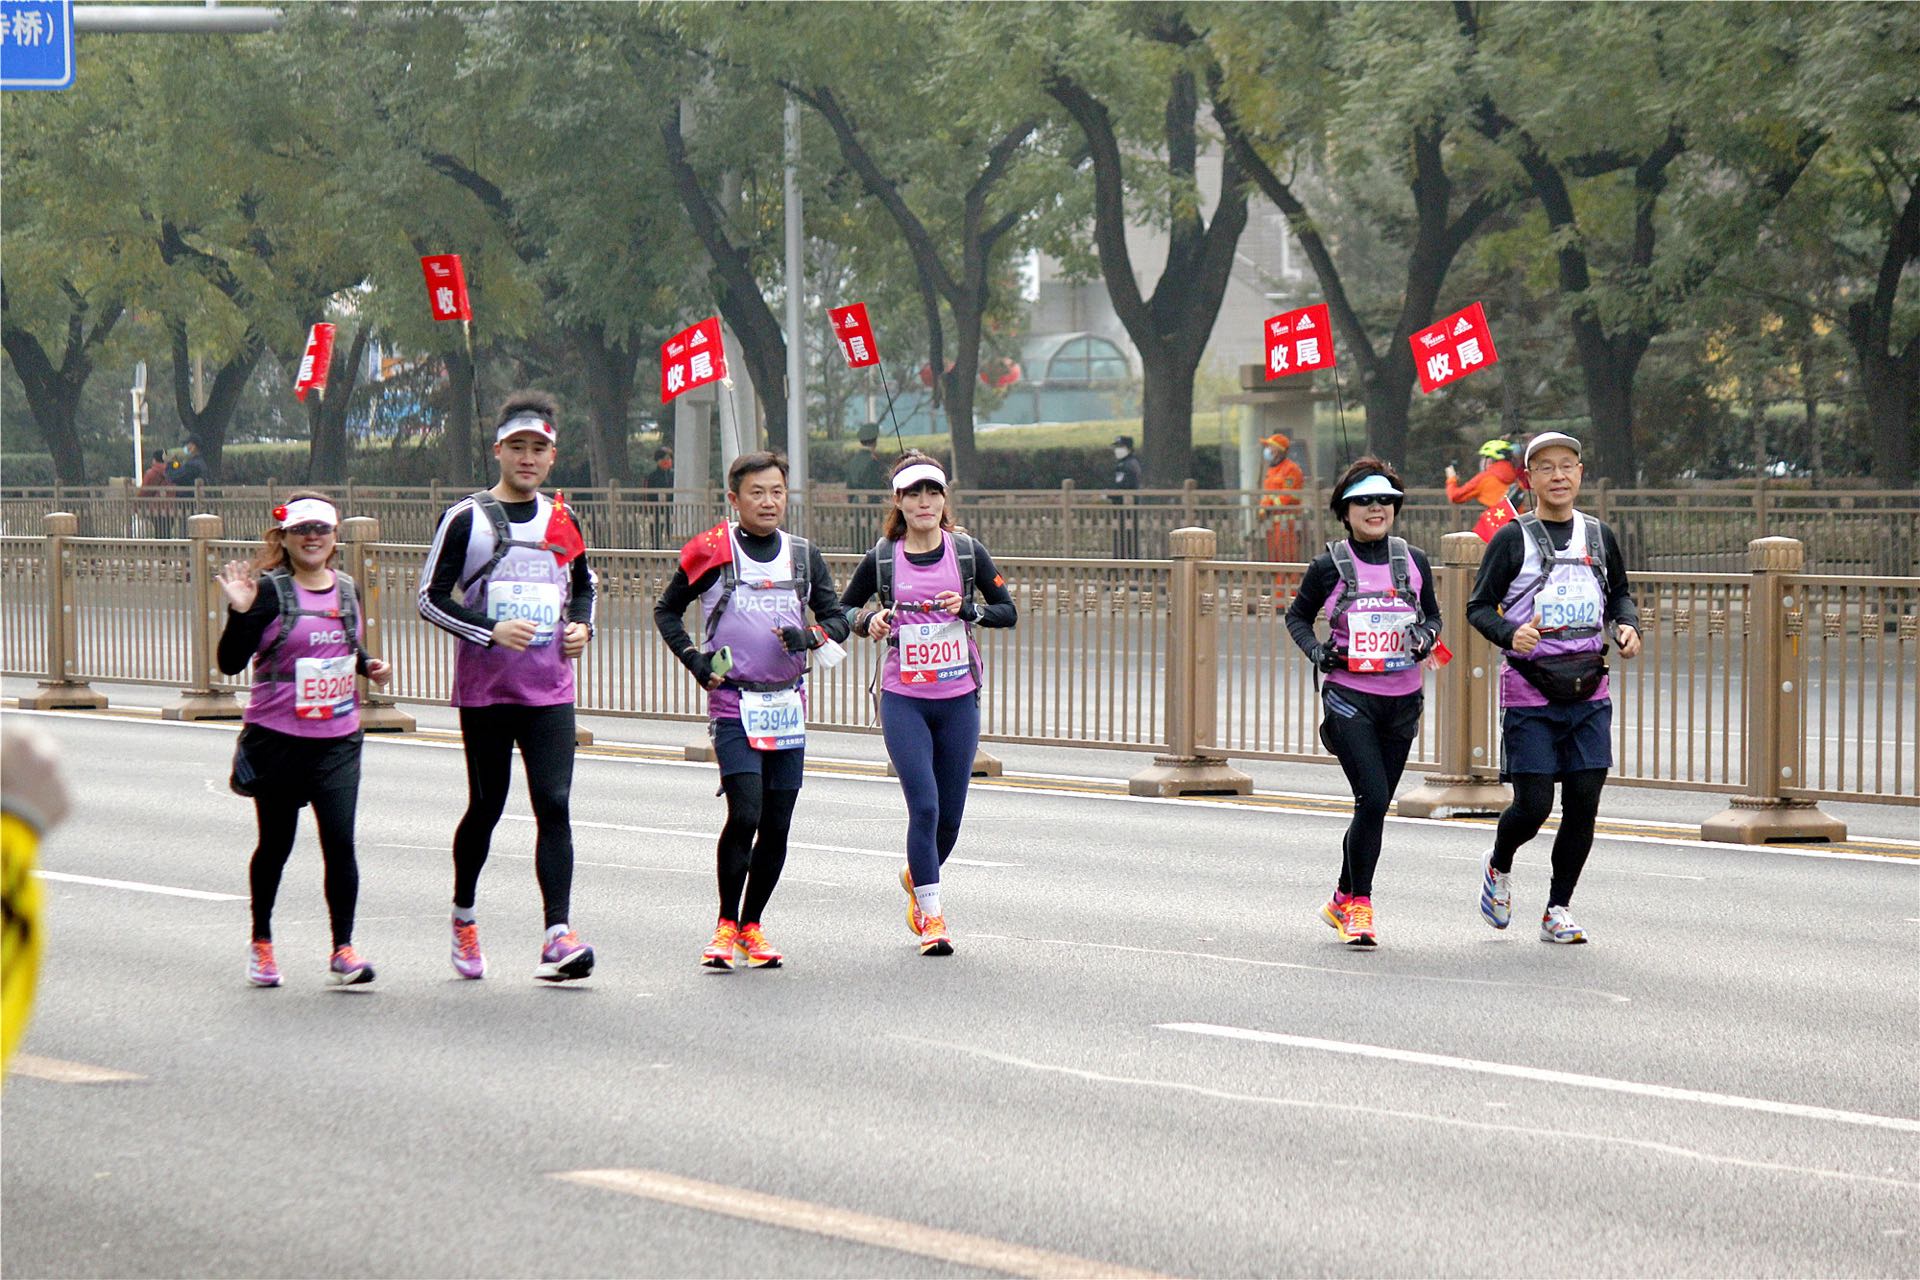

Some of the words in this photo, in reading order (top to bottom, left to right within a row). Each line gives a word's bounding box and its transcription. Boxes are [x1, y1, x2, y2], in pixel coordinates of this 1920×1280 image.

[1271, 337, 1321, 373] 收尾
[1427, 337, 1484, 382] 收尾
[667, 351, 713, 393] 收尾
[495, 602, 554, 626] F3940
[736, 595, 799, 613] PACER
[1356, 597, 1409, 611] PACE
[1541, 602, 1595, 626] F3942
[905, 640, 961, 666] E9201
[303, 674, 354, 701] E9205
[747, 707, 799, 732] F3944
